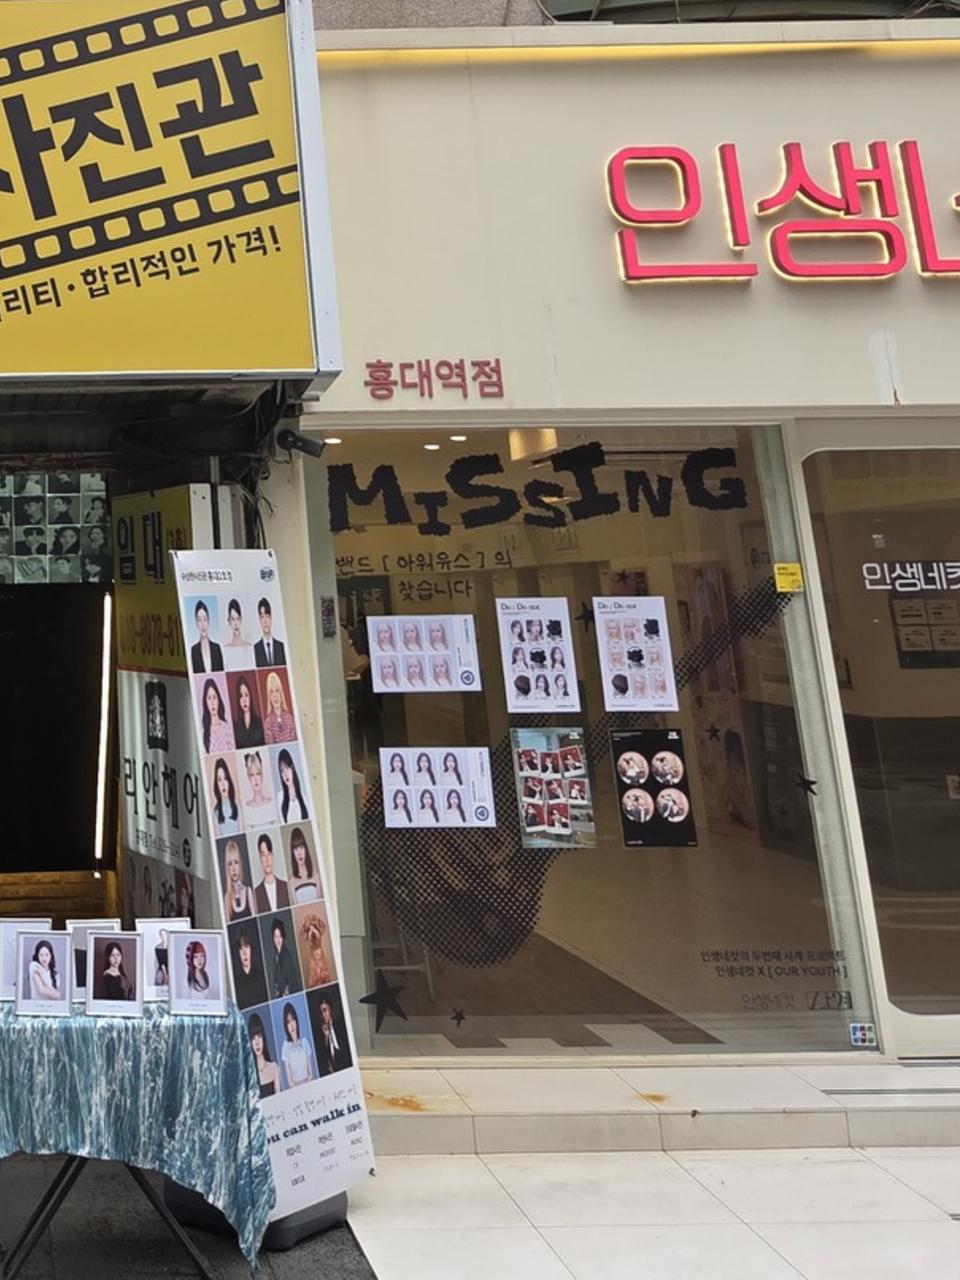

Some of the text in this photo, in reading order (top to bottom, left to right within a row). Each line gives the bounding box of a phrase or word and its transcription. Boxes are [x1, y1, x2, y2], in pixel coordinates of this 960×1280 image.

[211, 225, 282, 267] 가격!
[363, 357, 505, 399] 홍대역점
[116, 509, 163, 586] 임대
[398, 579, 473, 601] 찾습니다
[123, 756, 202, 838] 리안헤어
